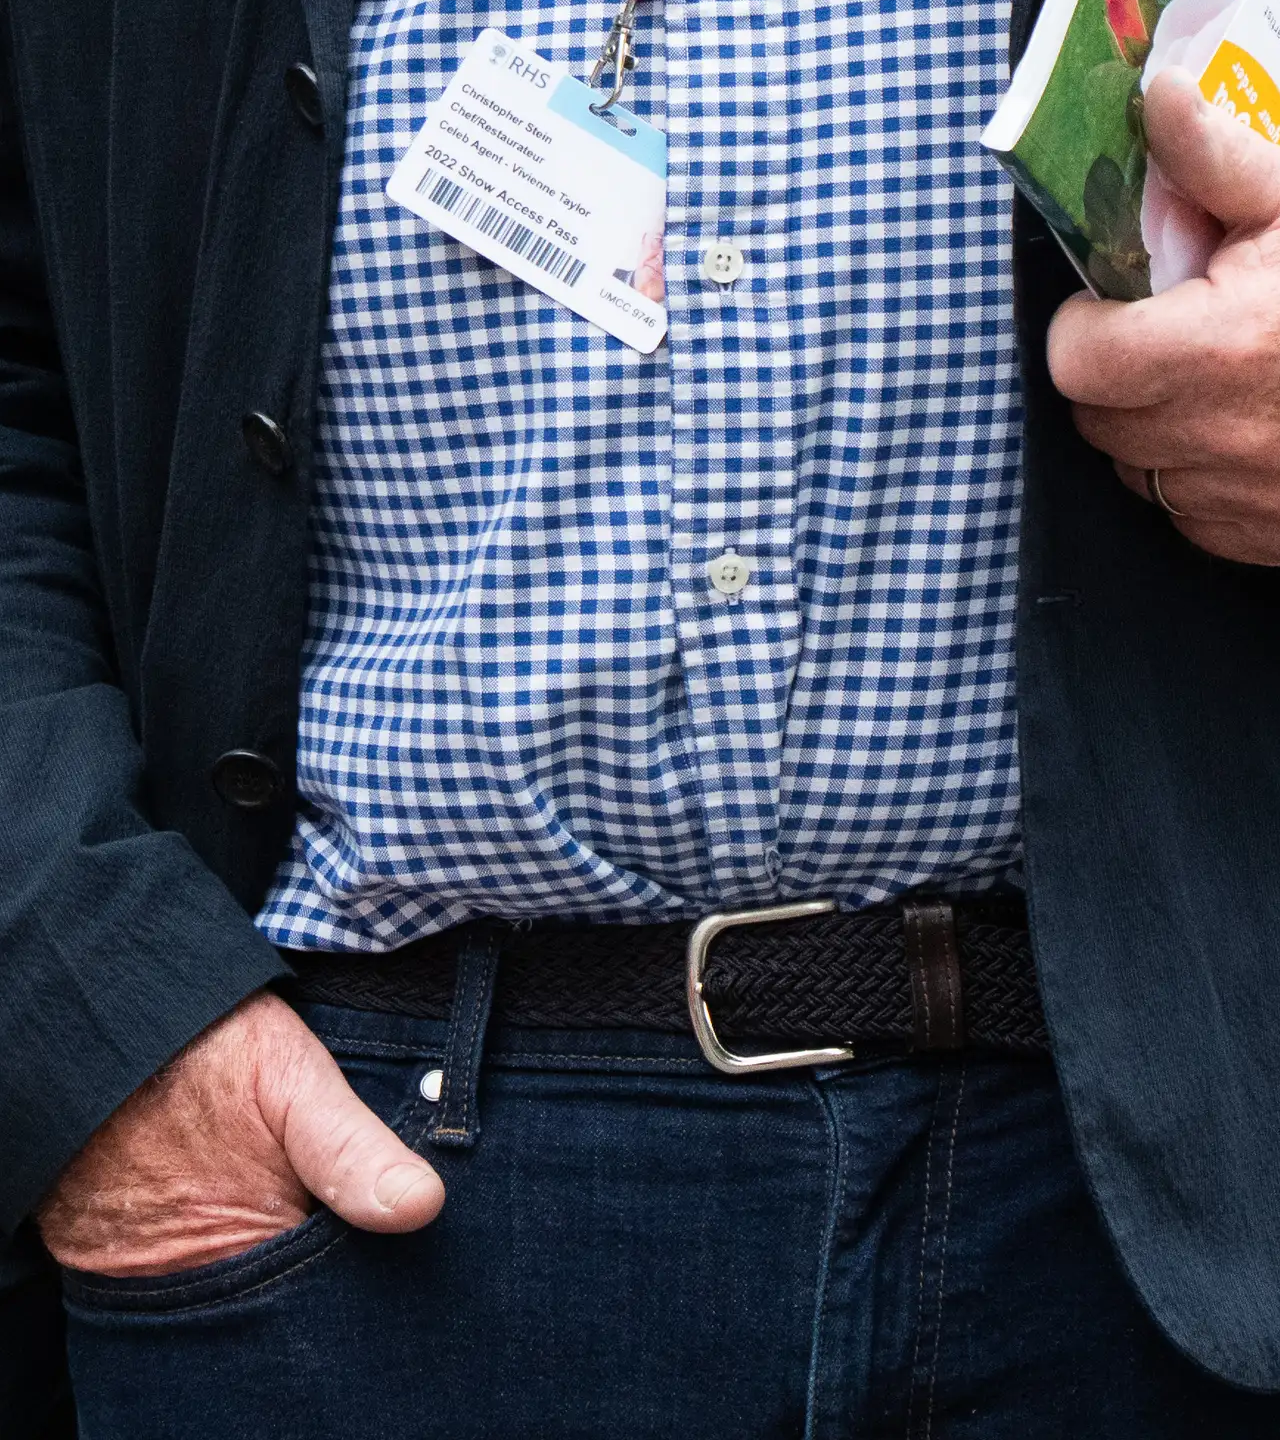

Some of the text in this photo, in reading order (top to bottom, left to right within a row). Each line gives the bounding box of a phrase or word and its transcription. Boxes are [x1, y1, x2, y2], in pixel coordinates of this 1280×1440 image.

[508, 56, 551, 89] RHS
[1231, 62, 1258, 105] order
[450, 101, 545, 164] Chef/Restaurateur
[461, 83, 552, 145] Christopher Stein
[425, 144, 579, 246] 2022 Show Access Pass
[439, 120, 469, 143] Celeb
[470, 139, 504, 165] Agent
[512, 162, 556, 197] Vivienne
[559, 191, 591, 218] Taylor
[599, 287, 657, 328] UMCC 9746
